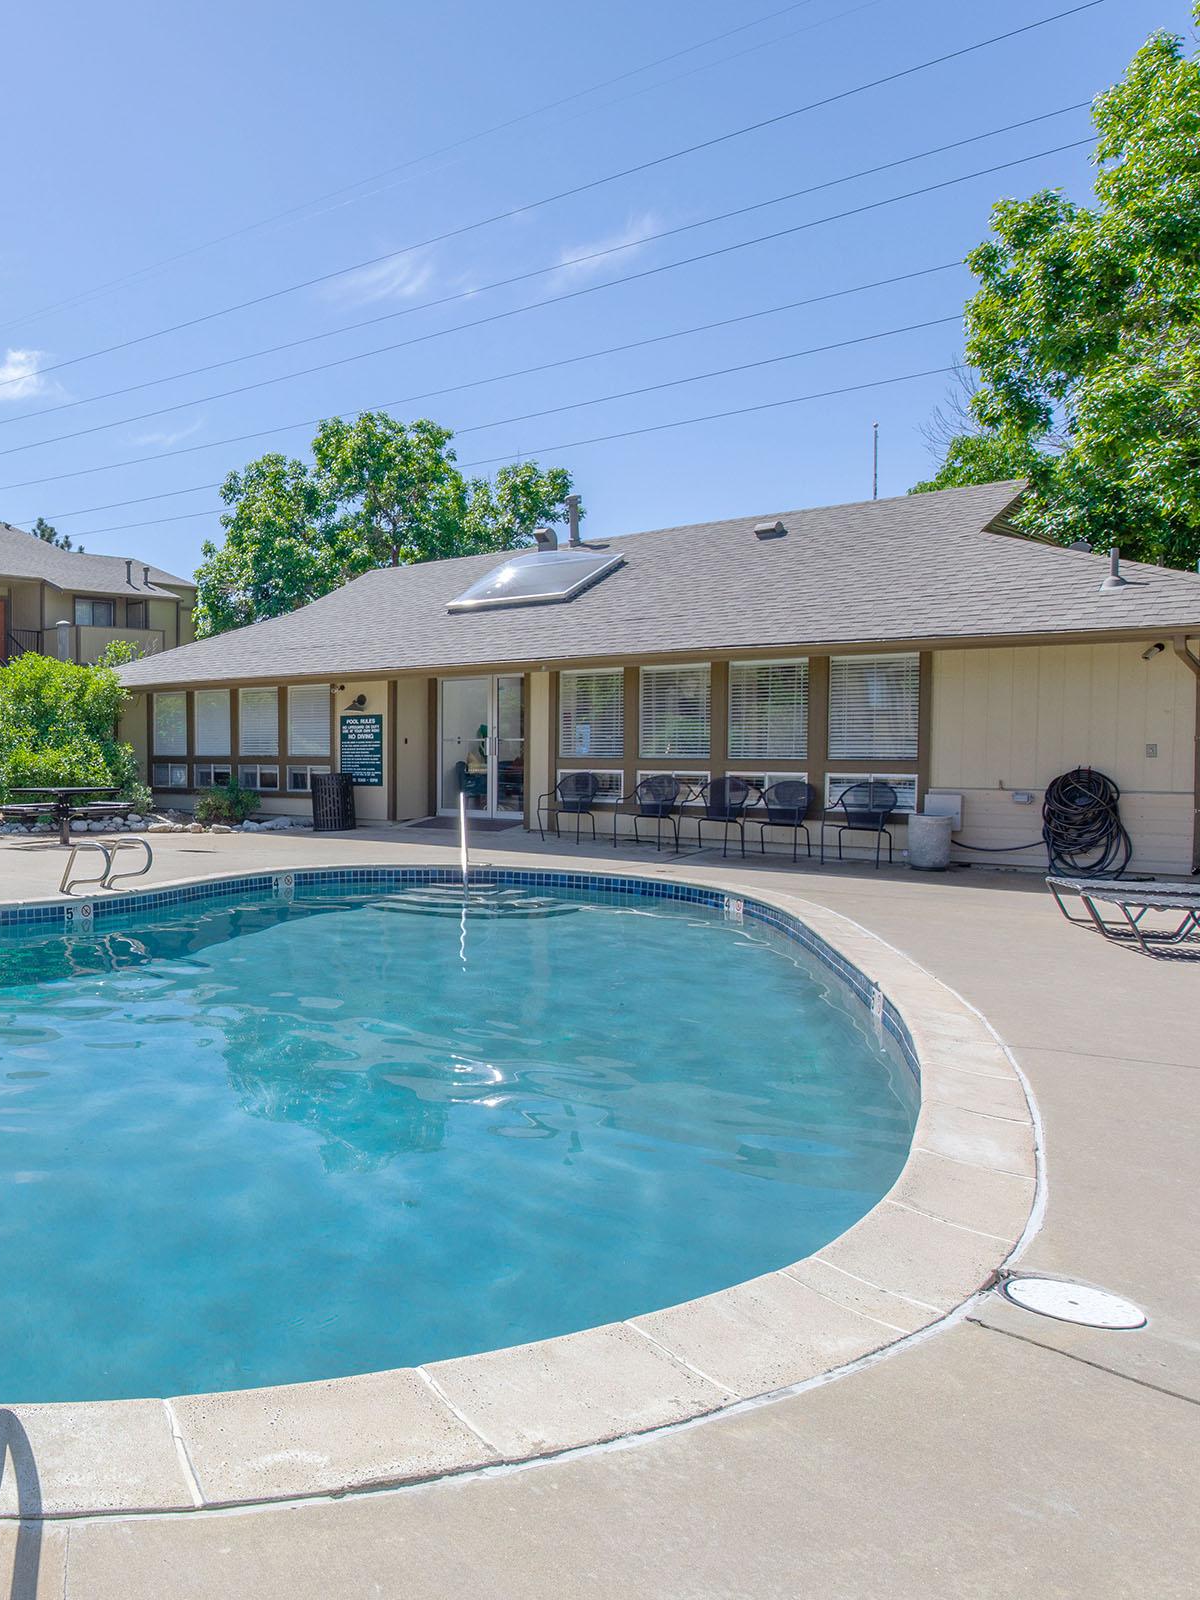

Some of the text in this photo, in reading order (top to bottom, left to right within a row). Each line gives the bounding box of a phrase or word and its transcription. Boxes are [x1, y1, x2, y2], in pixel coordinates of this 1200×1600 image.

[273, 877, 279, 889] 4
[725, 897, 731, 909] 4
[66, 907, 74, 920] 5
